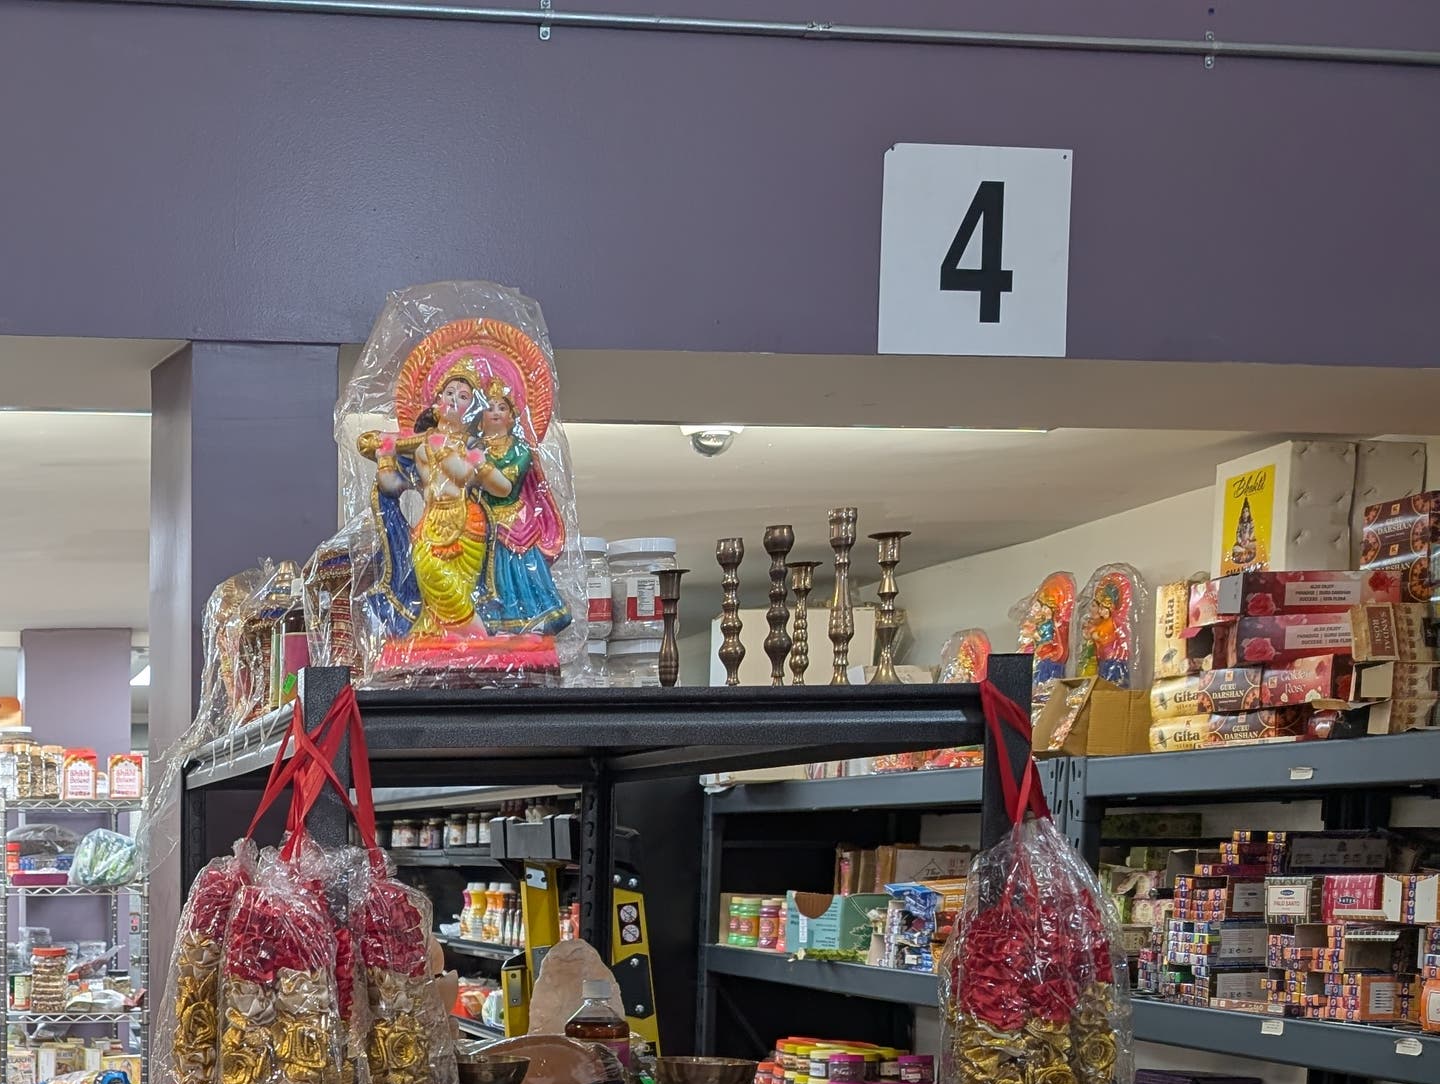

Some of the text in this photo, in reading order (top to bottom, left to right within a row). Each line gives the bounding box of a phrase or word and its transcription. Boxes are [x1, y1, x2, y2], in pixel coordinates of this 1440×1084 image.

[939, 180, 1014, 324] 4
[1164, 597, 1176, 639] Gita
[1212, 689, 1245, 699] DARSHAN
[1284, 683, 1306, 695] Rose
[1173, 690, 1200, 703] Gita
[1173, 729, 1200, 742] Gita
